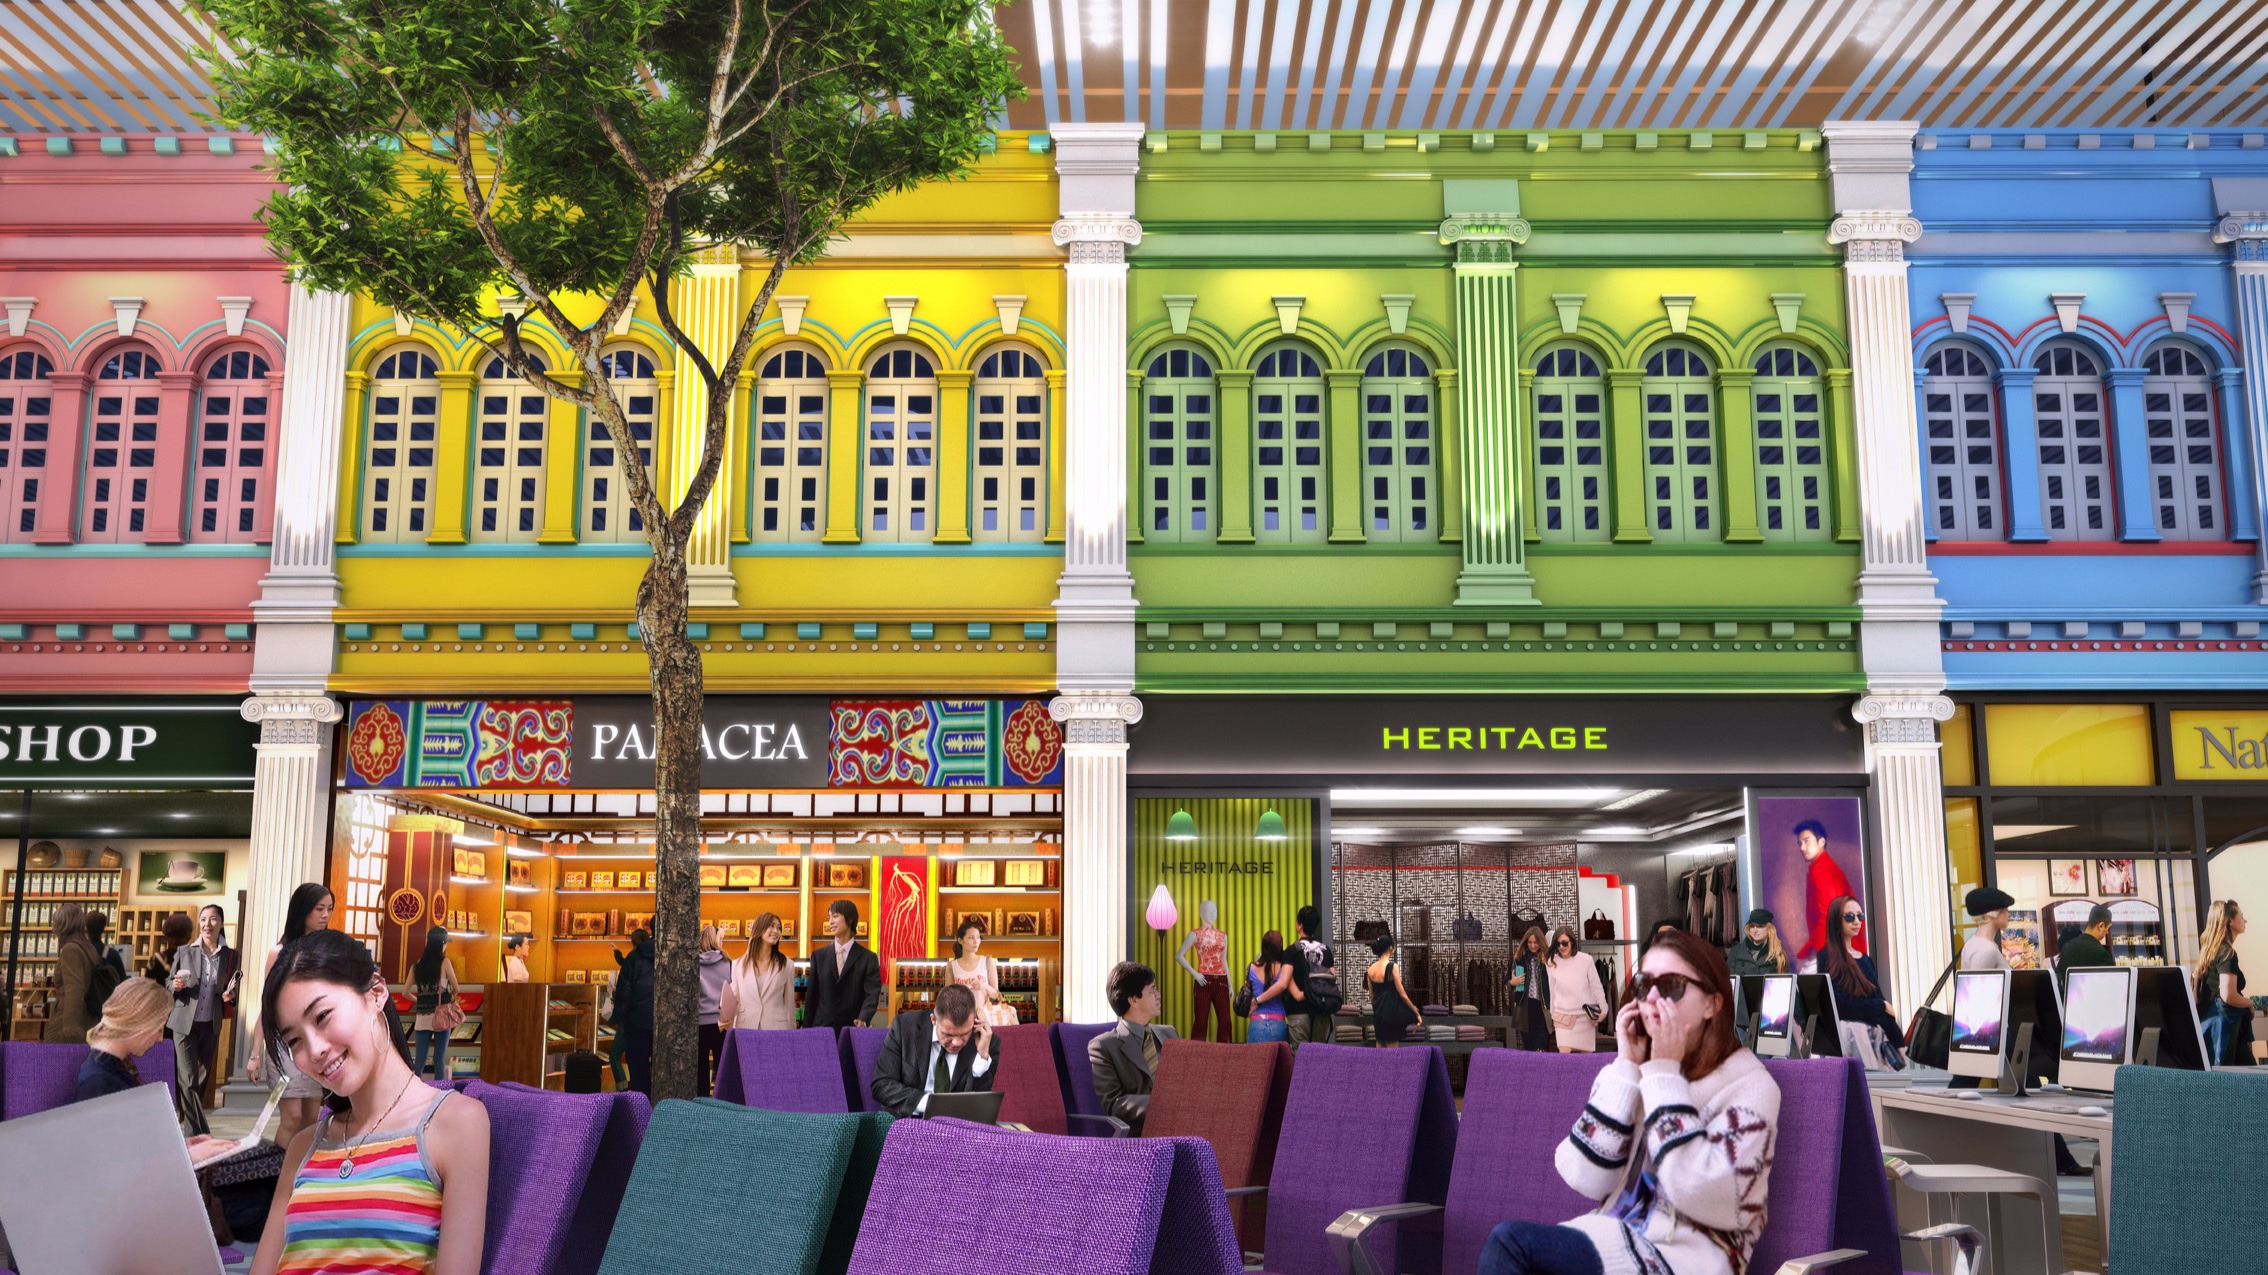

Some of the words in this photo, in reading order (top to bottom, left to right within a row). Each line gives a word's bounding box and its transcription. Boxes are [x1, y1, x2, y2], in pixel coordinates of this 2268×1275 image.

[590, 723, 808, 760] PAACEA
[1383, 727, 1608, 750] HERITAGE
[1161, 862, 1274, 874] HERITAGE
